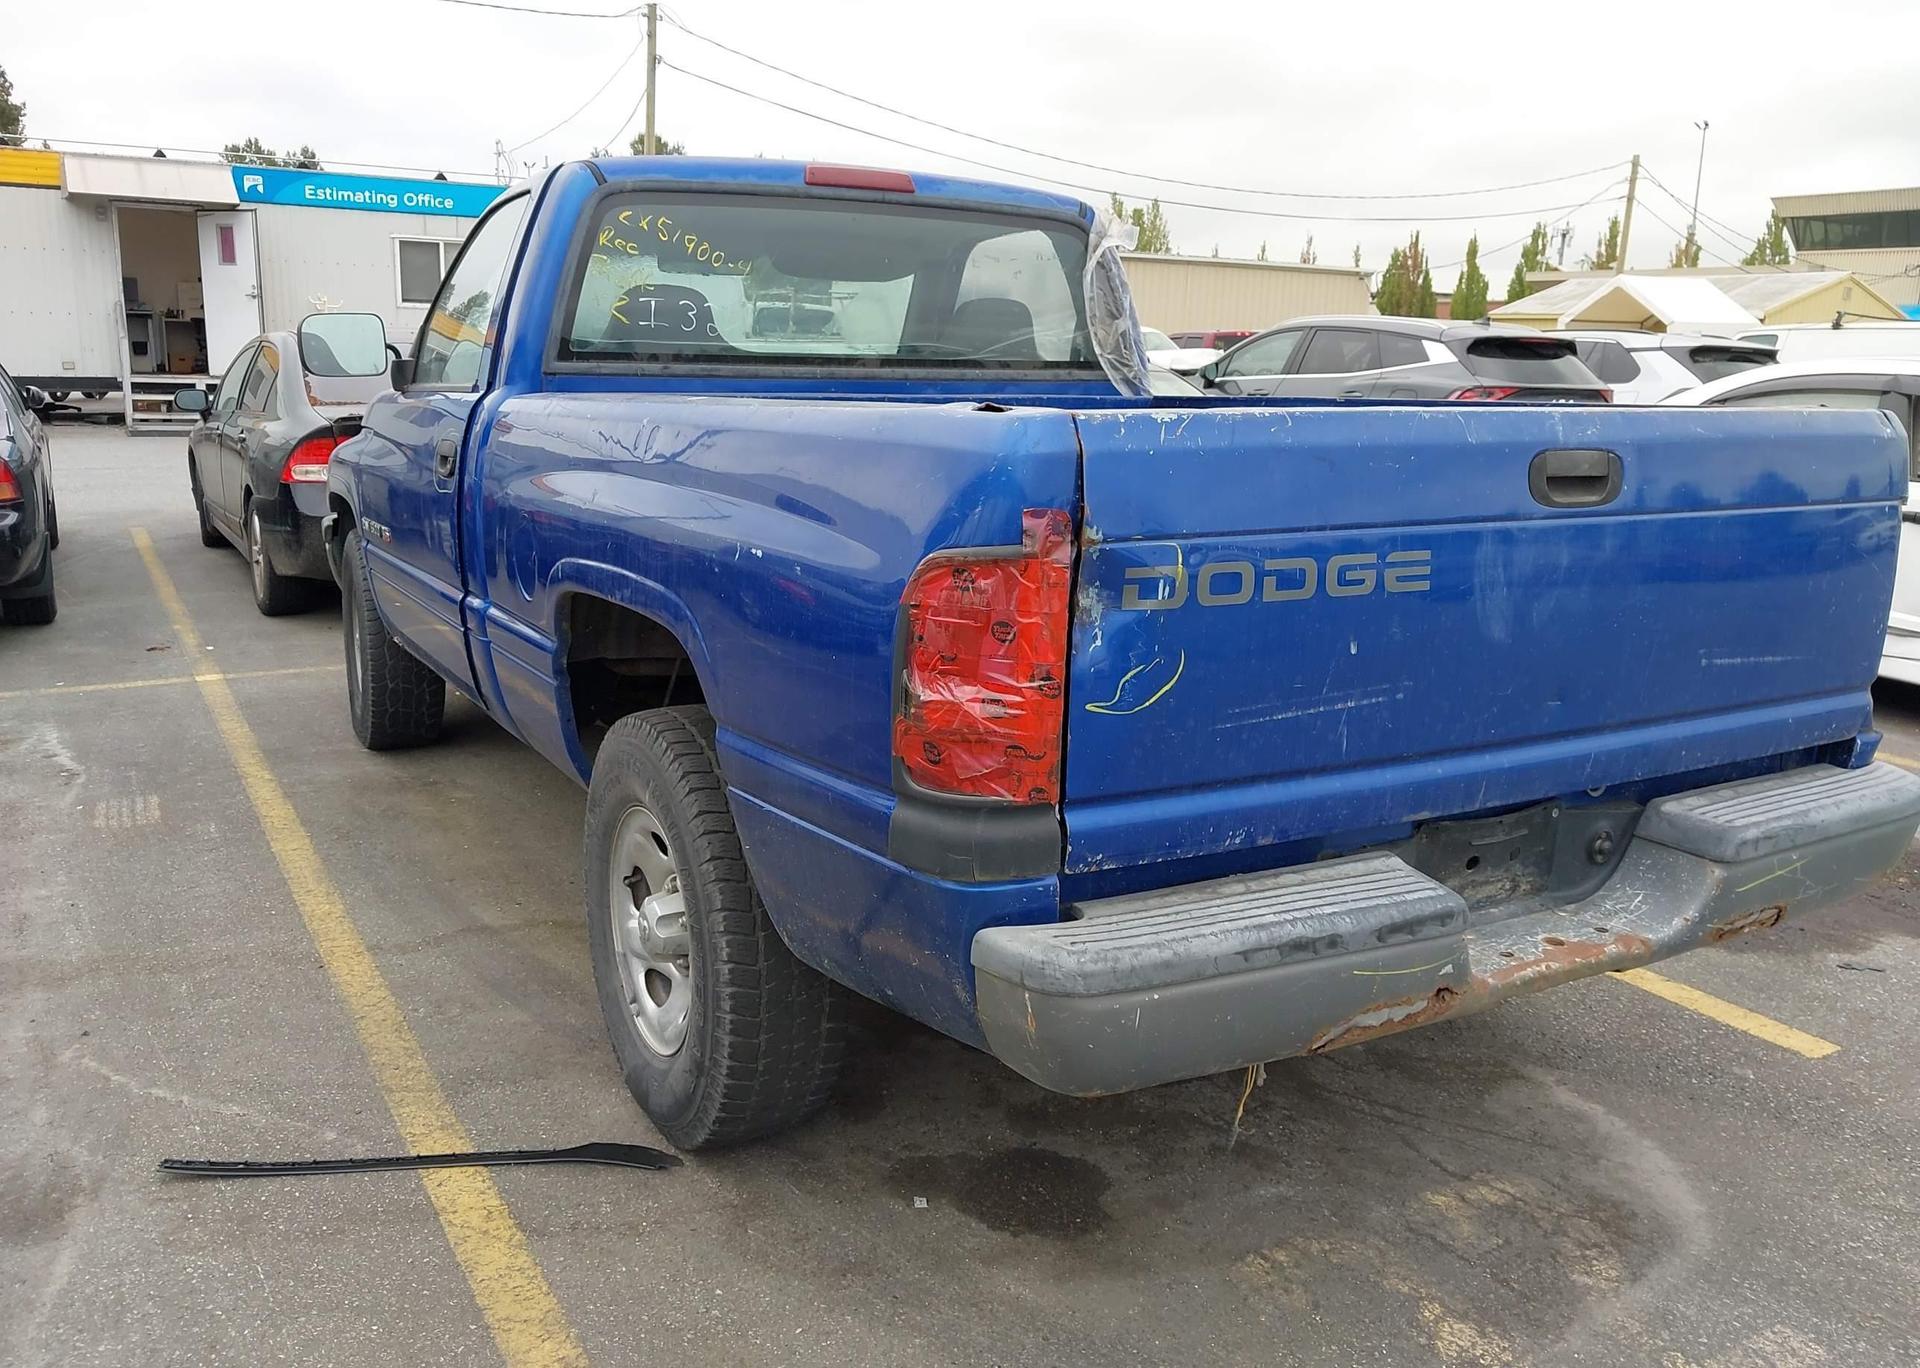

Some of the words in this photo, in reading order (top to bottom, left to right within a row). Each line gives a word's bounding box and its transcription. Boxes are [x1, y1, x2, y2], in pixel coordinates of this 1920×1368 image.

[304, 184, 398, 208] Estimating
[404, 192, 454, 209] Office
[1122, 550, 1432, 611] DODGE
